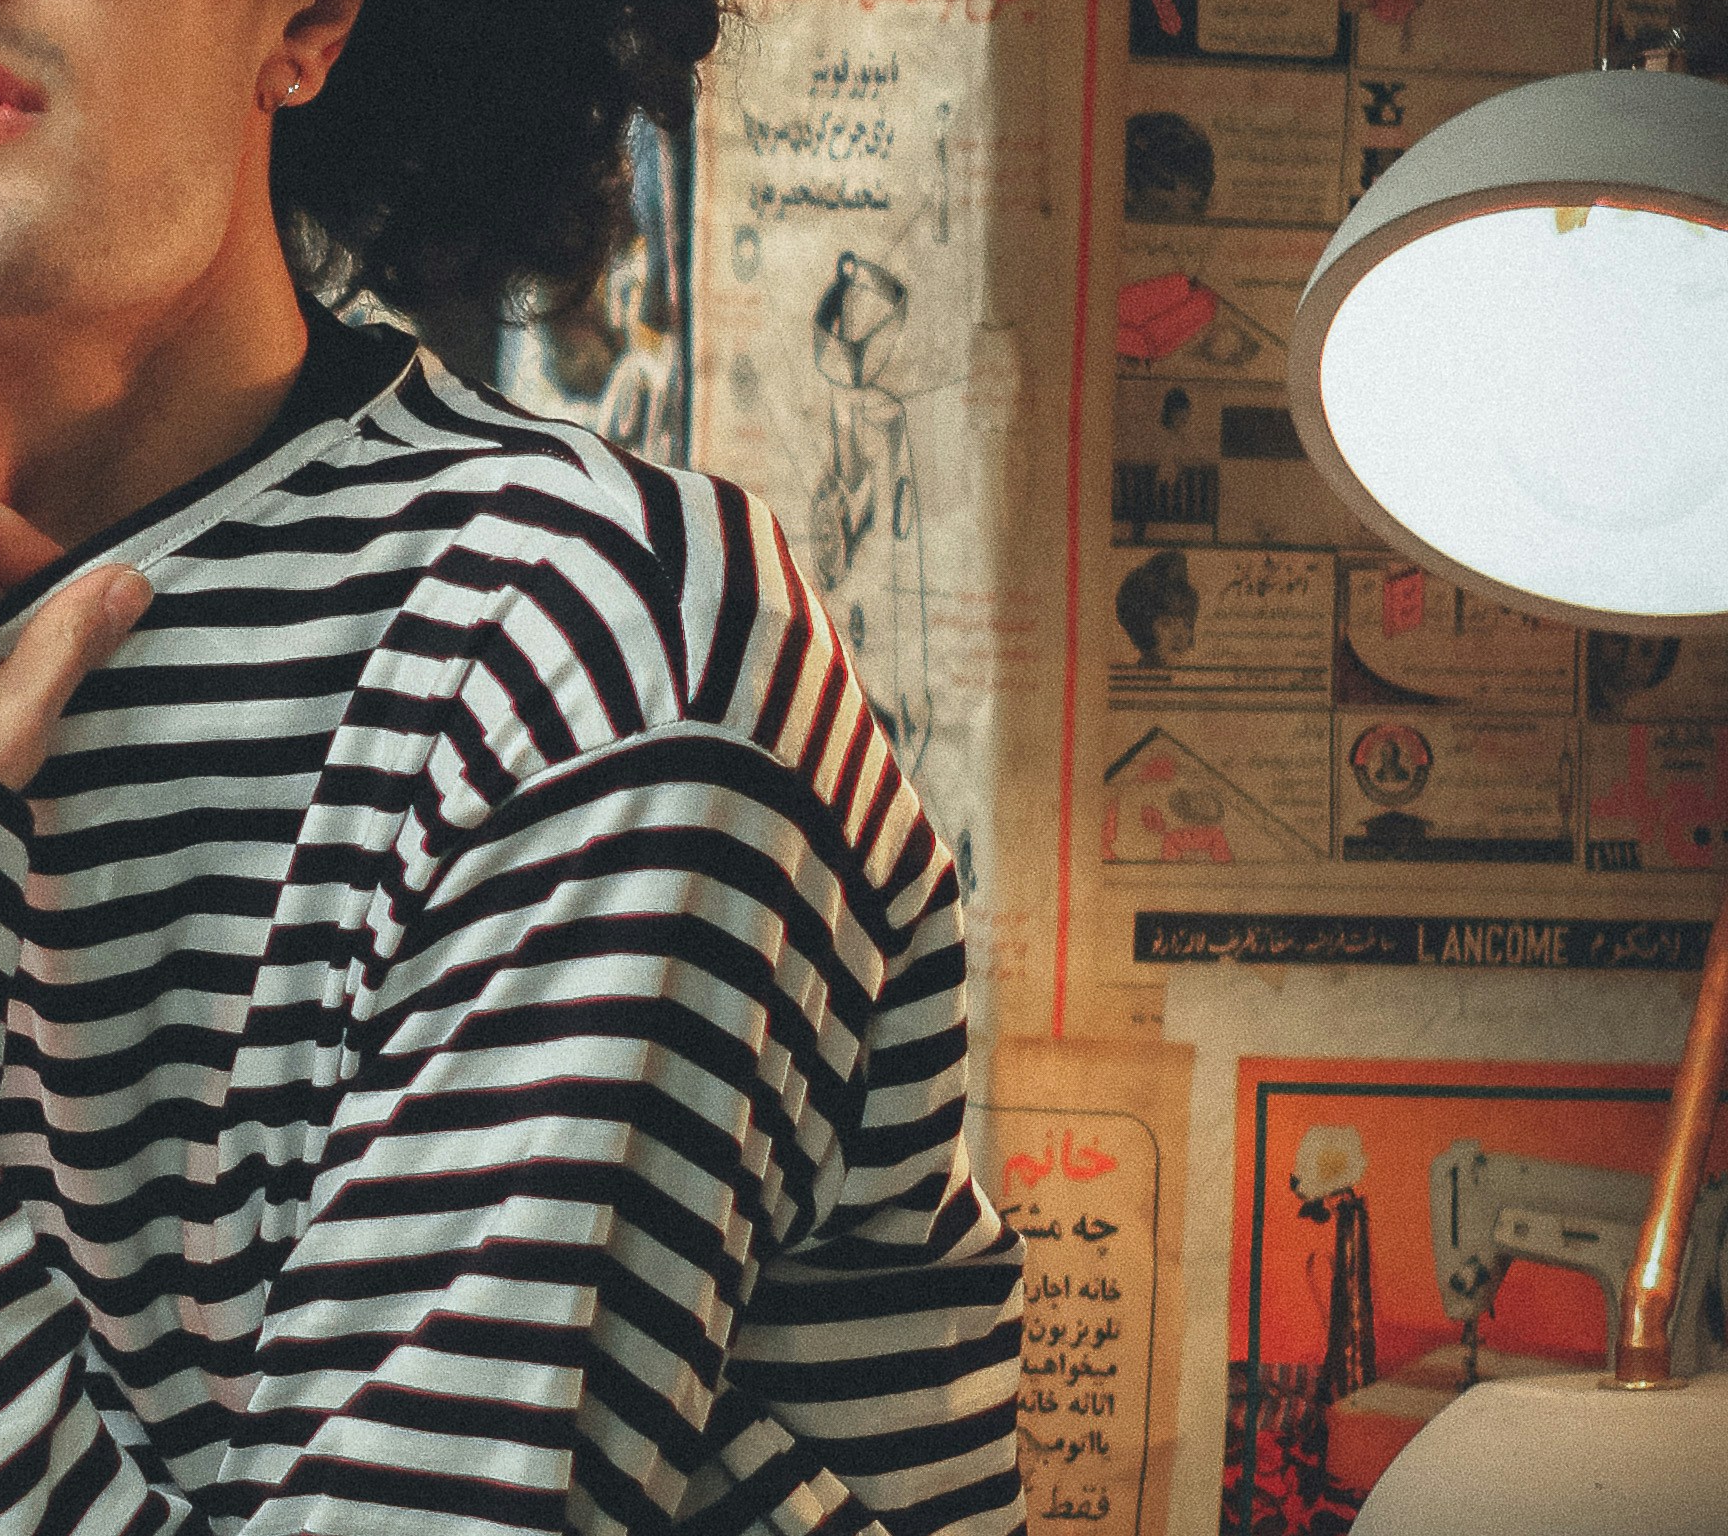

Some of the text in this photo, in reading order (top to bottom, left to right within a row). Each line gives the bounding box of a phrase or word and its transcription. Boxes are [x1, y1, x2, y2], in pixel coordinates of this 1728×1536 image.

[1003, 1129, 1119, 1196] خانم
[999, 1204, 1119, 1257] چه مشک
[1023, 1274, 1122, 1308] خانه اجار
[1041, 1484, 1112, 1521] فقط
